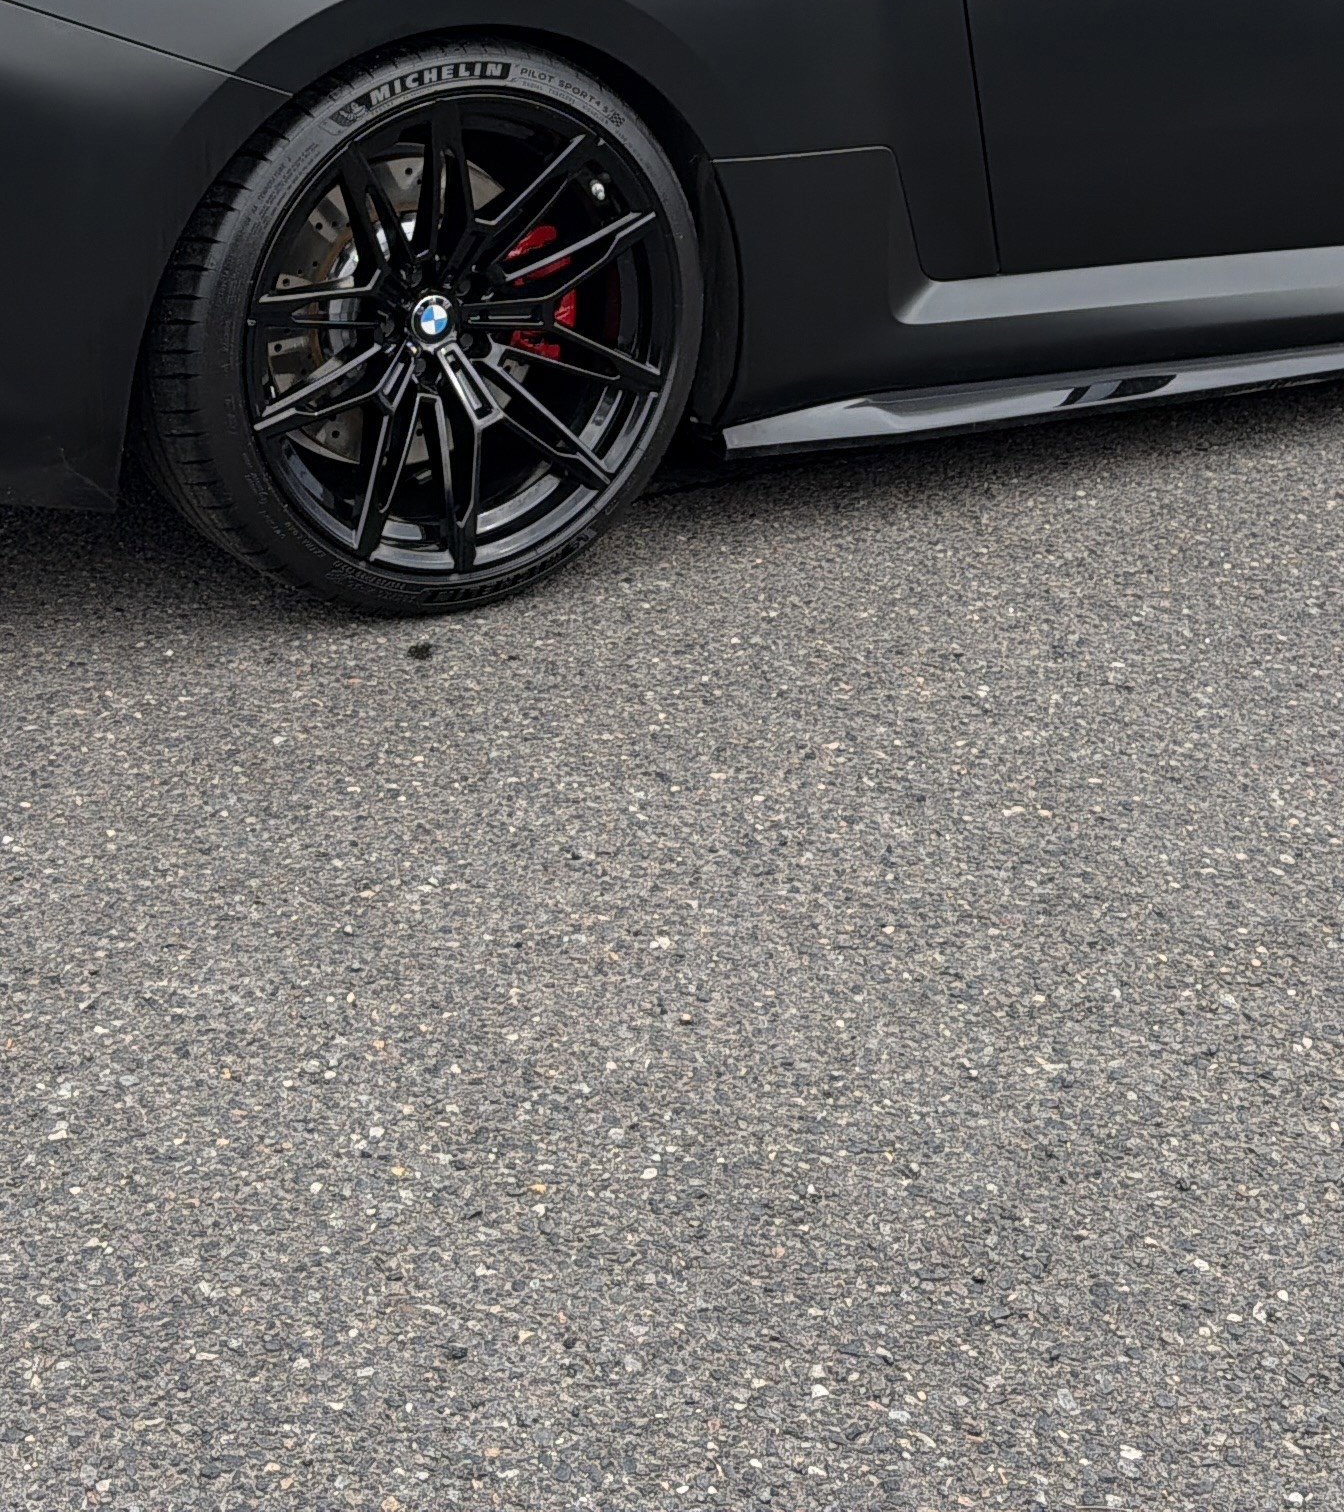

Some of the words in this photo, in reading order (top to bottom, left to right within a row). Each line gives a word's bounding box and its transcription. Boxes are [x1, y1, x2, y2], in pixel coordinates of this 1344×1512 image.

[370, 62, 504, 107] MICHELIN
[520, 67, 555, 84] PILOT
[558, 79, 595, 102] SPORT
